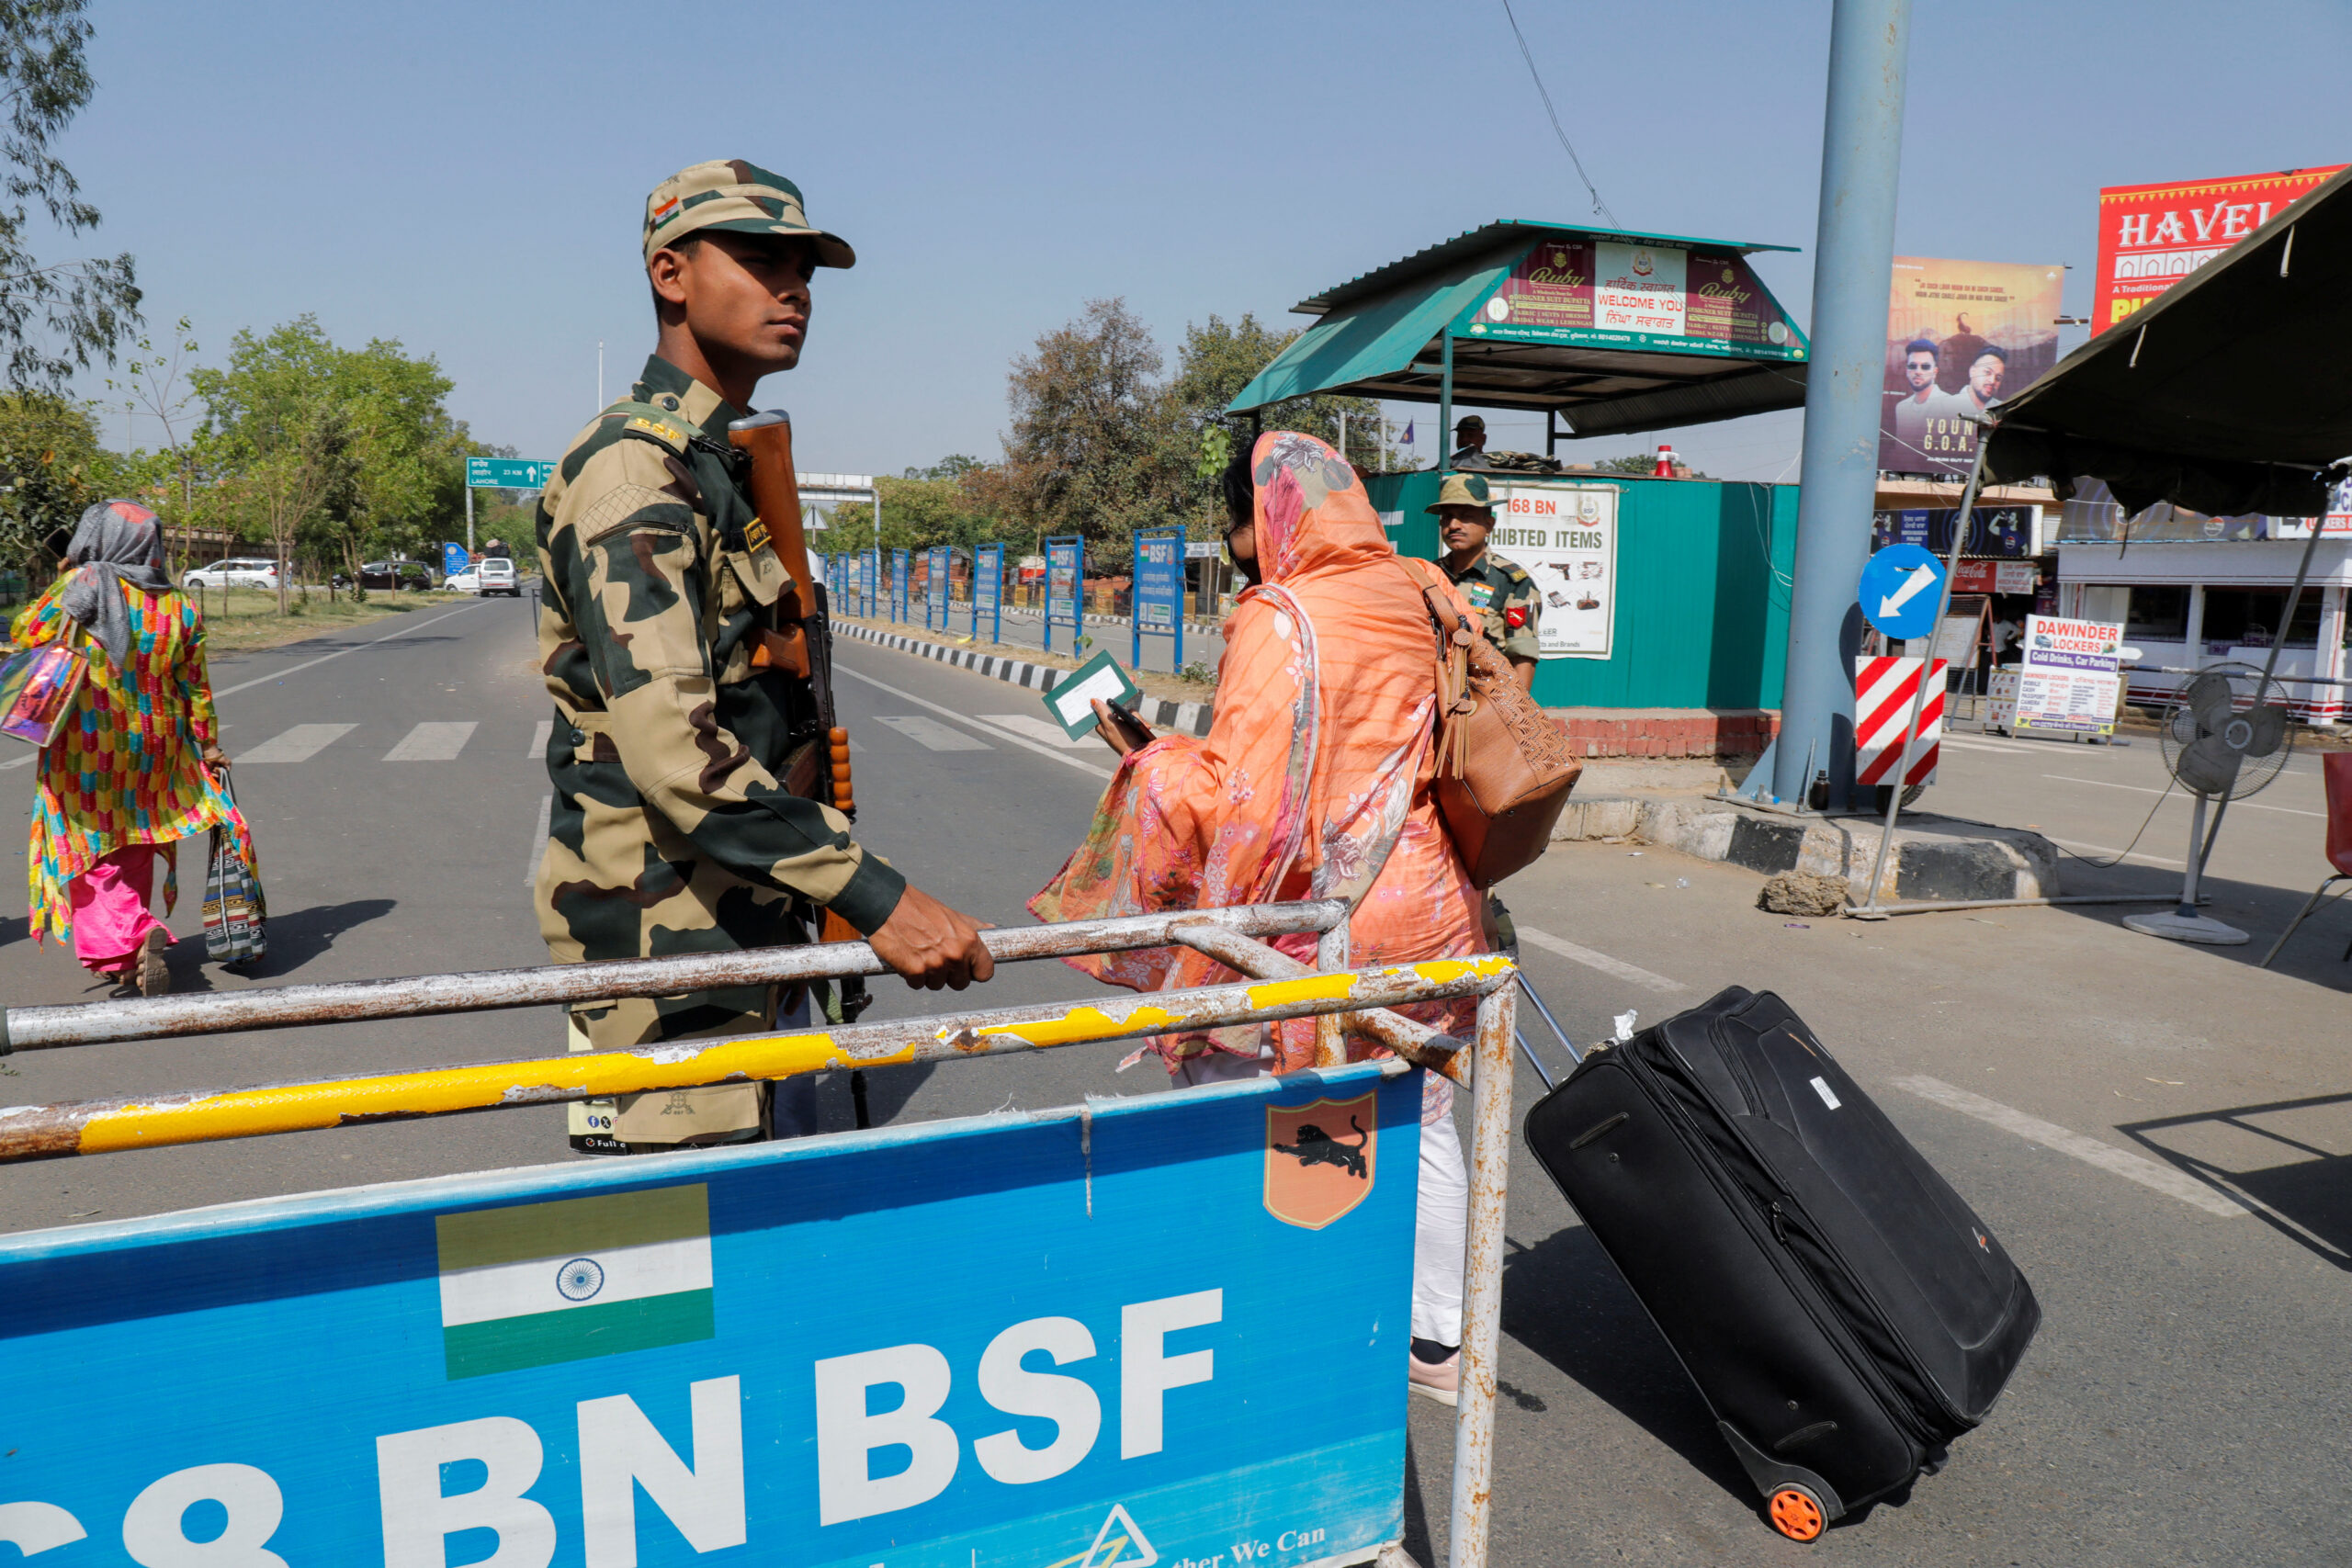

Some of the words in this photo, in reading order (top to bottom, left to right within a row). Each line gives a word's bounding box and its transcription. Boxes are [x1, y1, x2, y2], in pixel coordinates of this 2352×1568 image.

[2119, 199, 2298, 247] HAVE
[1529, 267, 1586, 288] Ruby
[1605, 276, 1637, 290] हार्दिक
[1640, 282, 1676, 293] स्वागत
[1599, 294, 1655, 310] WELCOME
[1659, 299, 1683, 311] YOU
[1698, 282, 1751, 303] Ruby
[634, 417, 682, 441] BSF
[1926, 418, 1973, 435] YOUN
[1924, 434, 1974, 452] G.O.A.
[1507, 498, 1530, 513] 168
[1535, 500, 1555, 514] BN
[1487, 528, 1546, 547] HIBTED
[1555, 531, 1602, 549] ITEMS
[1149, 545, 1167, 563] BSF
[2037, 620, 2118, 641] DAWINDER
[2053, 637, 2101, 653] LOCKERS
[2032, 651, 2048, 662] Cold
[2050, 653, 2074, 666] Drinks,
[2075, 656, 2087, 666] Car
[2089, 658, 2116, 671] Parking
[597, 1139, 616, 1147] Full
[376, 1374, 747, 1568] BN
[815, 1288, 1223, 1528] BSF
[1230, 1540, 1270, 1562] We
[1277, 1528, 1325, 1551] Can
